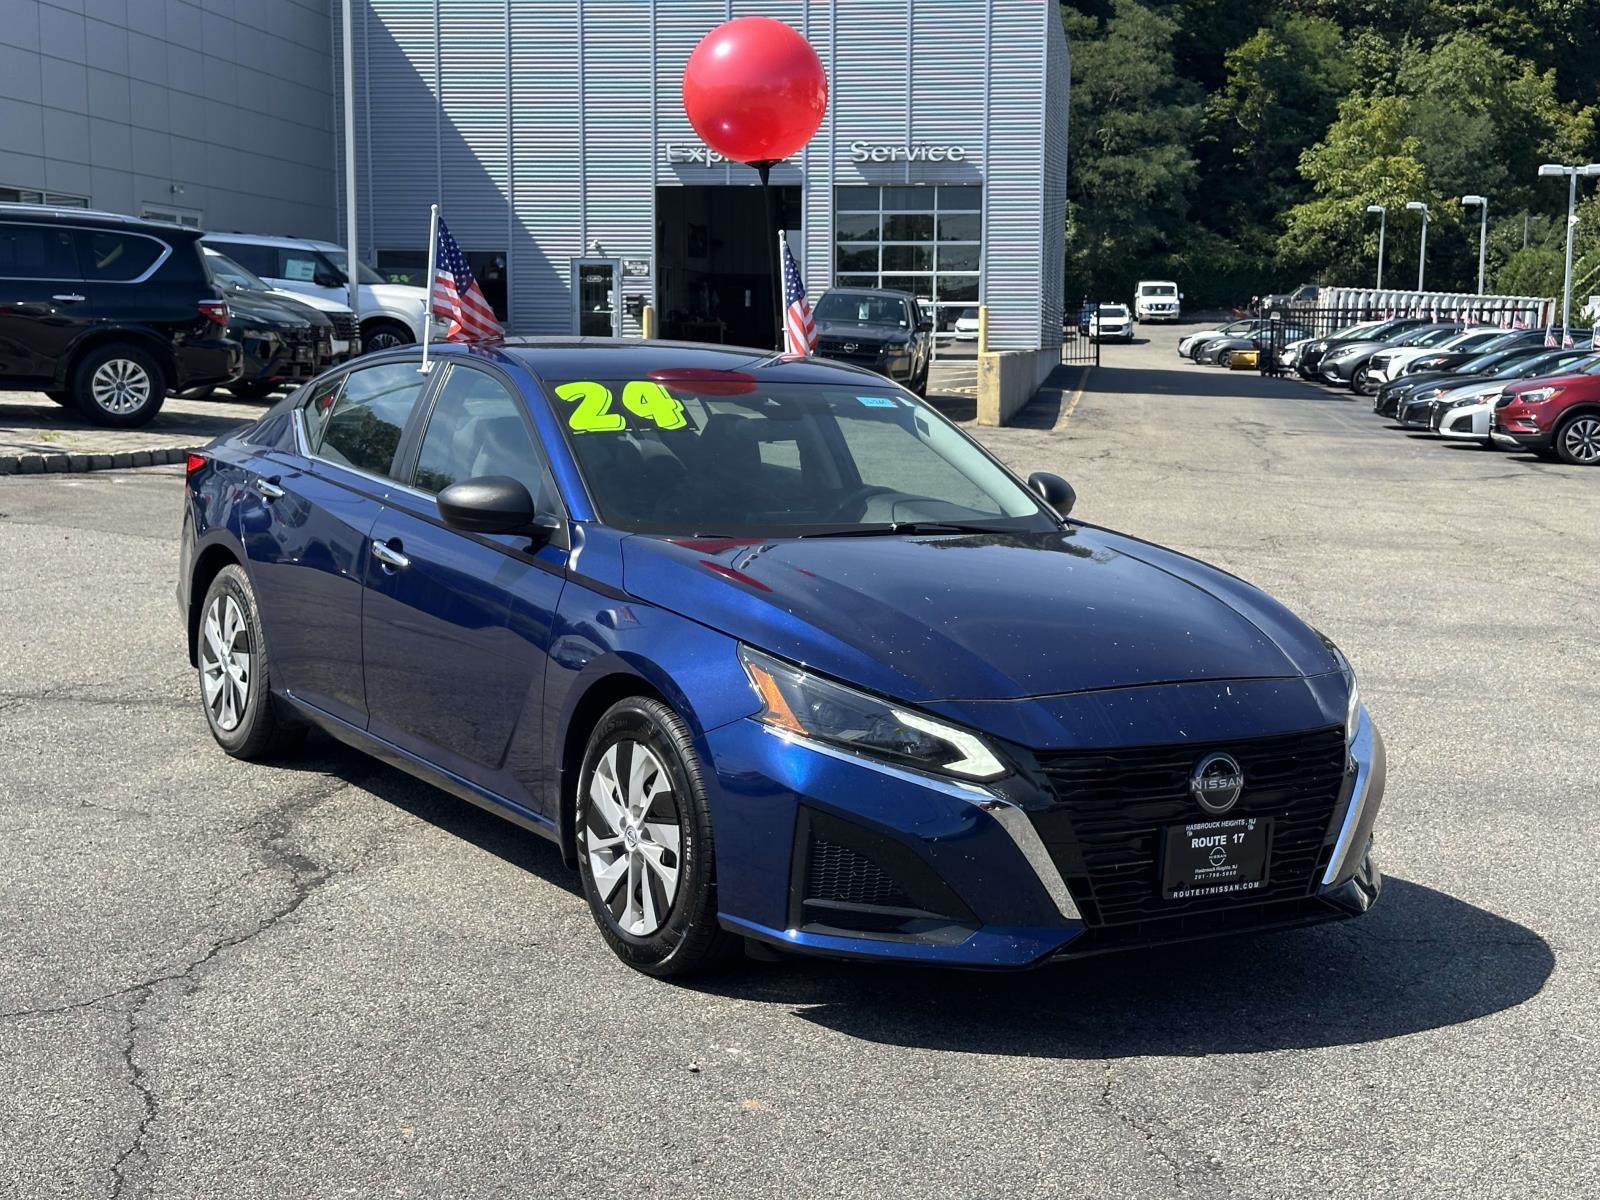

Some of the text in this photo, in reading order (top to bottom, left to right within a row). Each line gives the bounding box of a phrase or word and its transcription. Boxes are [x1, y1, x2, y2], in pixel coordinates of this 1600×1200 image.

[666, 143, 729, 168] Exp
[850, 141, 965, 161] Service
[554, 381, 688, 432] 24
[1191, 775, 1243, 790] NISSAN
[1191, 833, 1245, 849] ROUTE 17
[1173, 882, 1259, 899] ROUTE17NISSAN.COM
